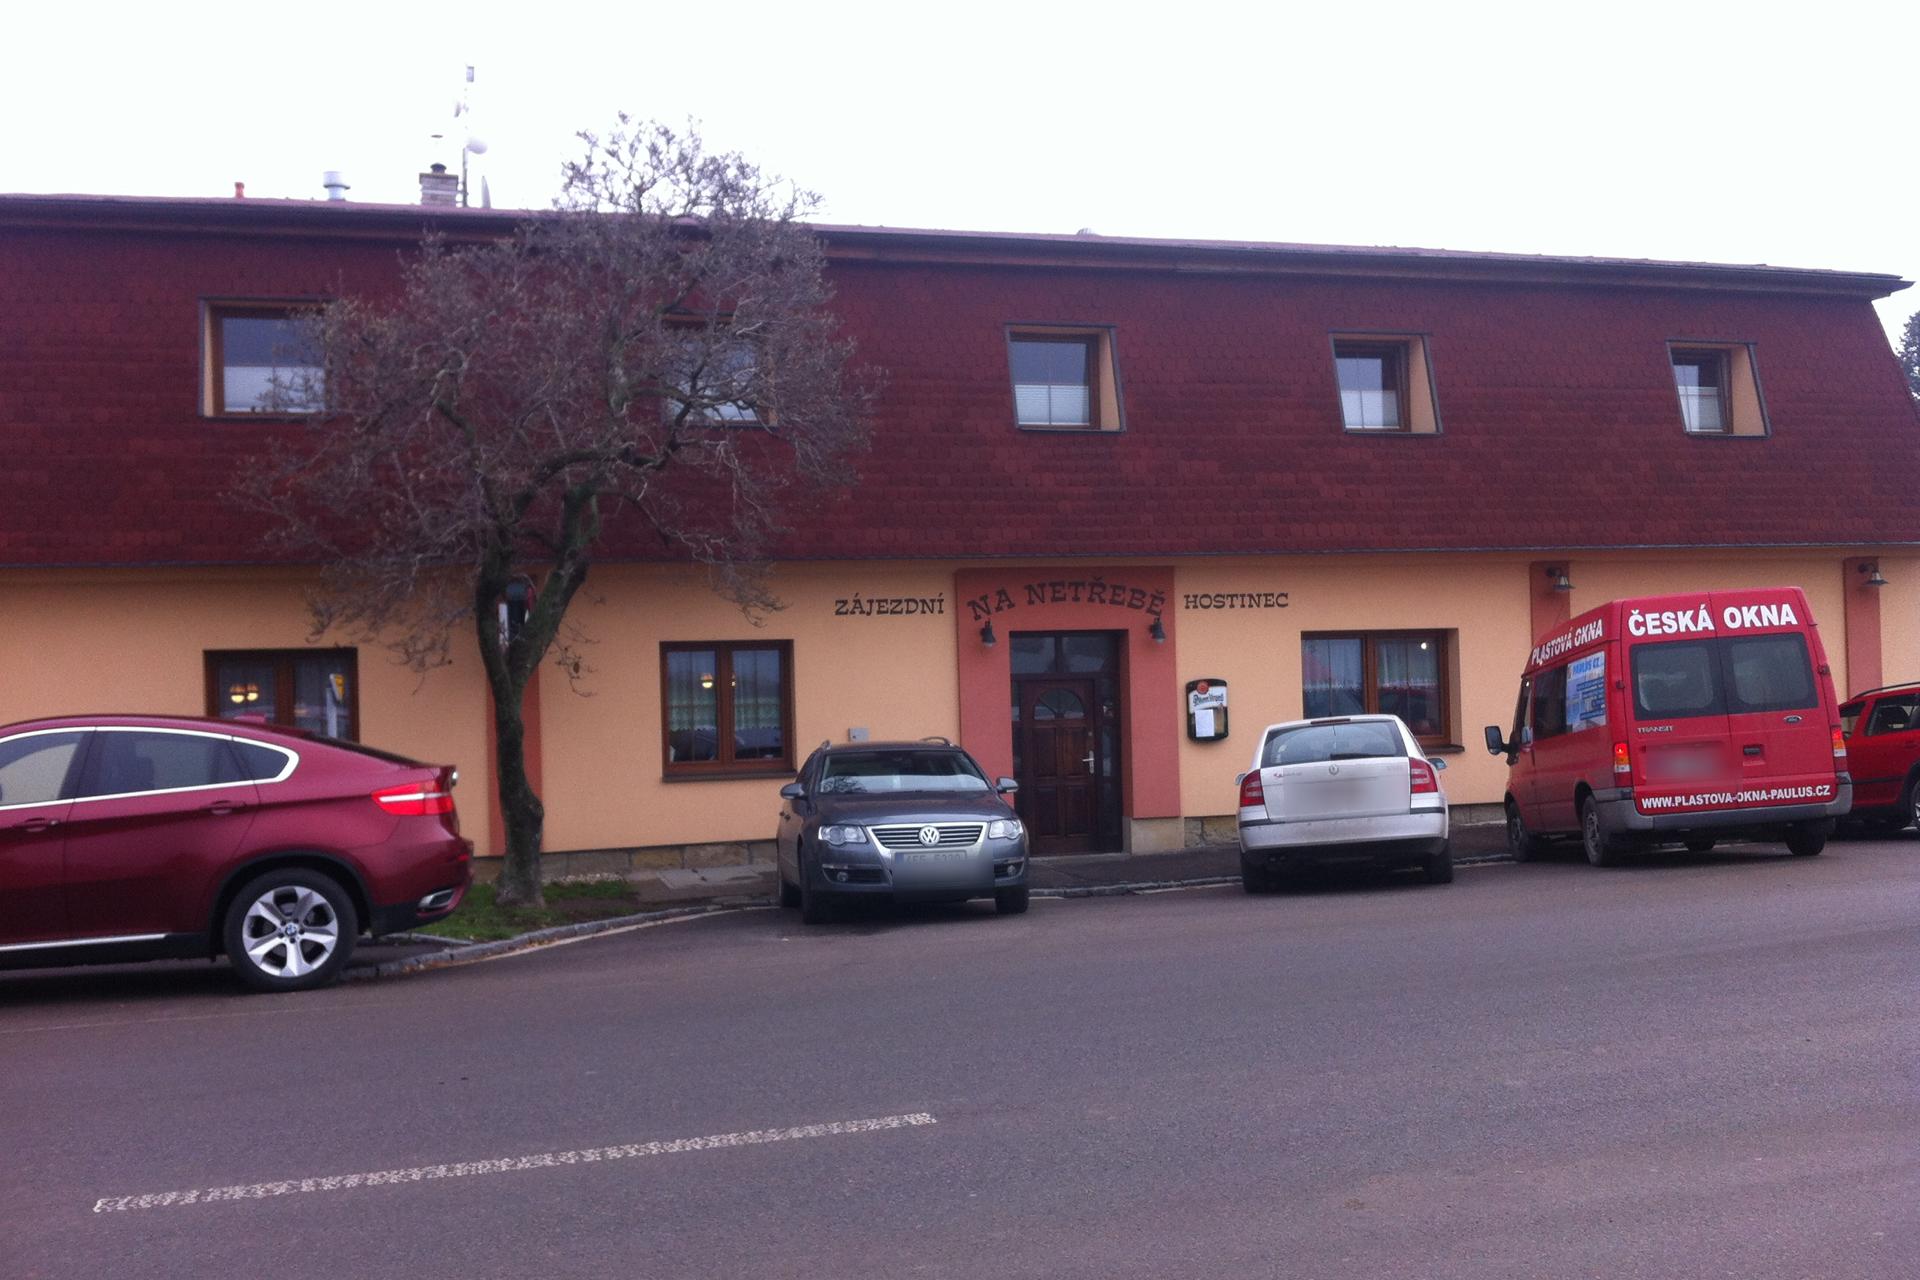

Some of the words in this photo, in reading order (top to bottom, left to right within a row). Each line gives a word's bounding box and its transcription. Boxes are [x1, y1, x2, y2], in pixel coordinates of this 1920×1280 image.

[834, 592, 945, 616] ZÁJEZDNÍ
[966, 586, 1016, 622] NA
[1024, 576, 1167, 617] NETŘEBĚ
[1183, 592, 1289, 610] HOSTINEC
[1628, 604, 1715, 637] ČESKÁ
[1722, 603, 1798, 629] OKNA
[1531, 626, 1573, 667] PLASTOVÁ
[1574, 618, 1603, 647] OKNA
[1641, 785, 1831, 810] WWW.PLASTOVA-OKNA-PAULUS.CZ
